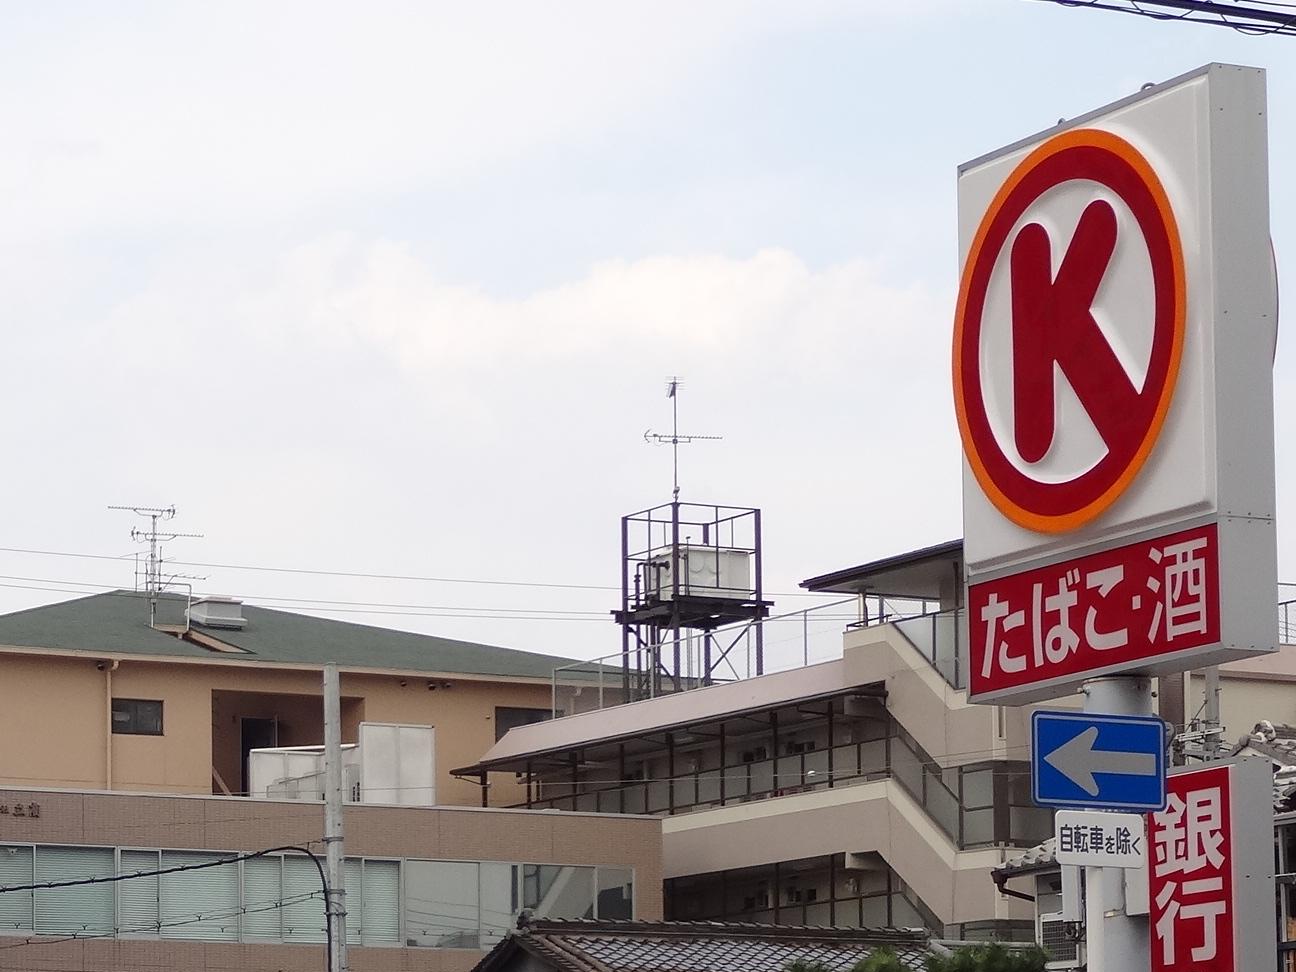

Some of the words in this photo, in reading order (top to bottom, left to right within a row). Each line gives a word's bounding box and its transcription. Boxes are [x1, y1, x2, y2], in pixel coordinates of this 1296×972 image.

[981, 536, 1207, 678] たばこ・酒
[1060, 824, 1141, 855] 自転車を除く
